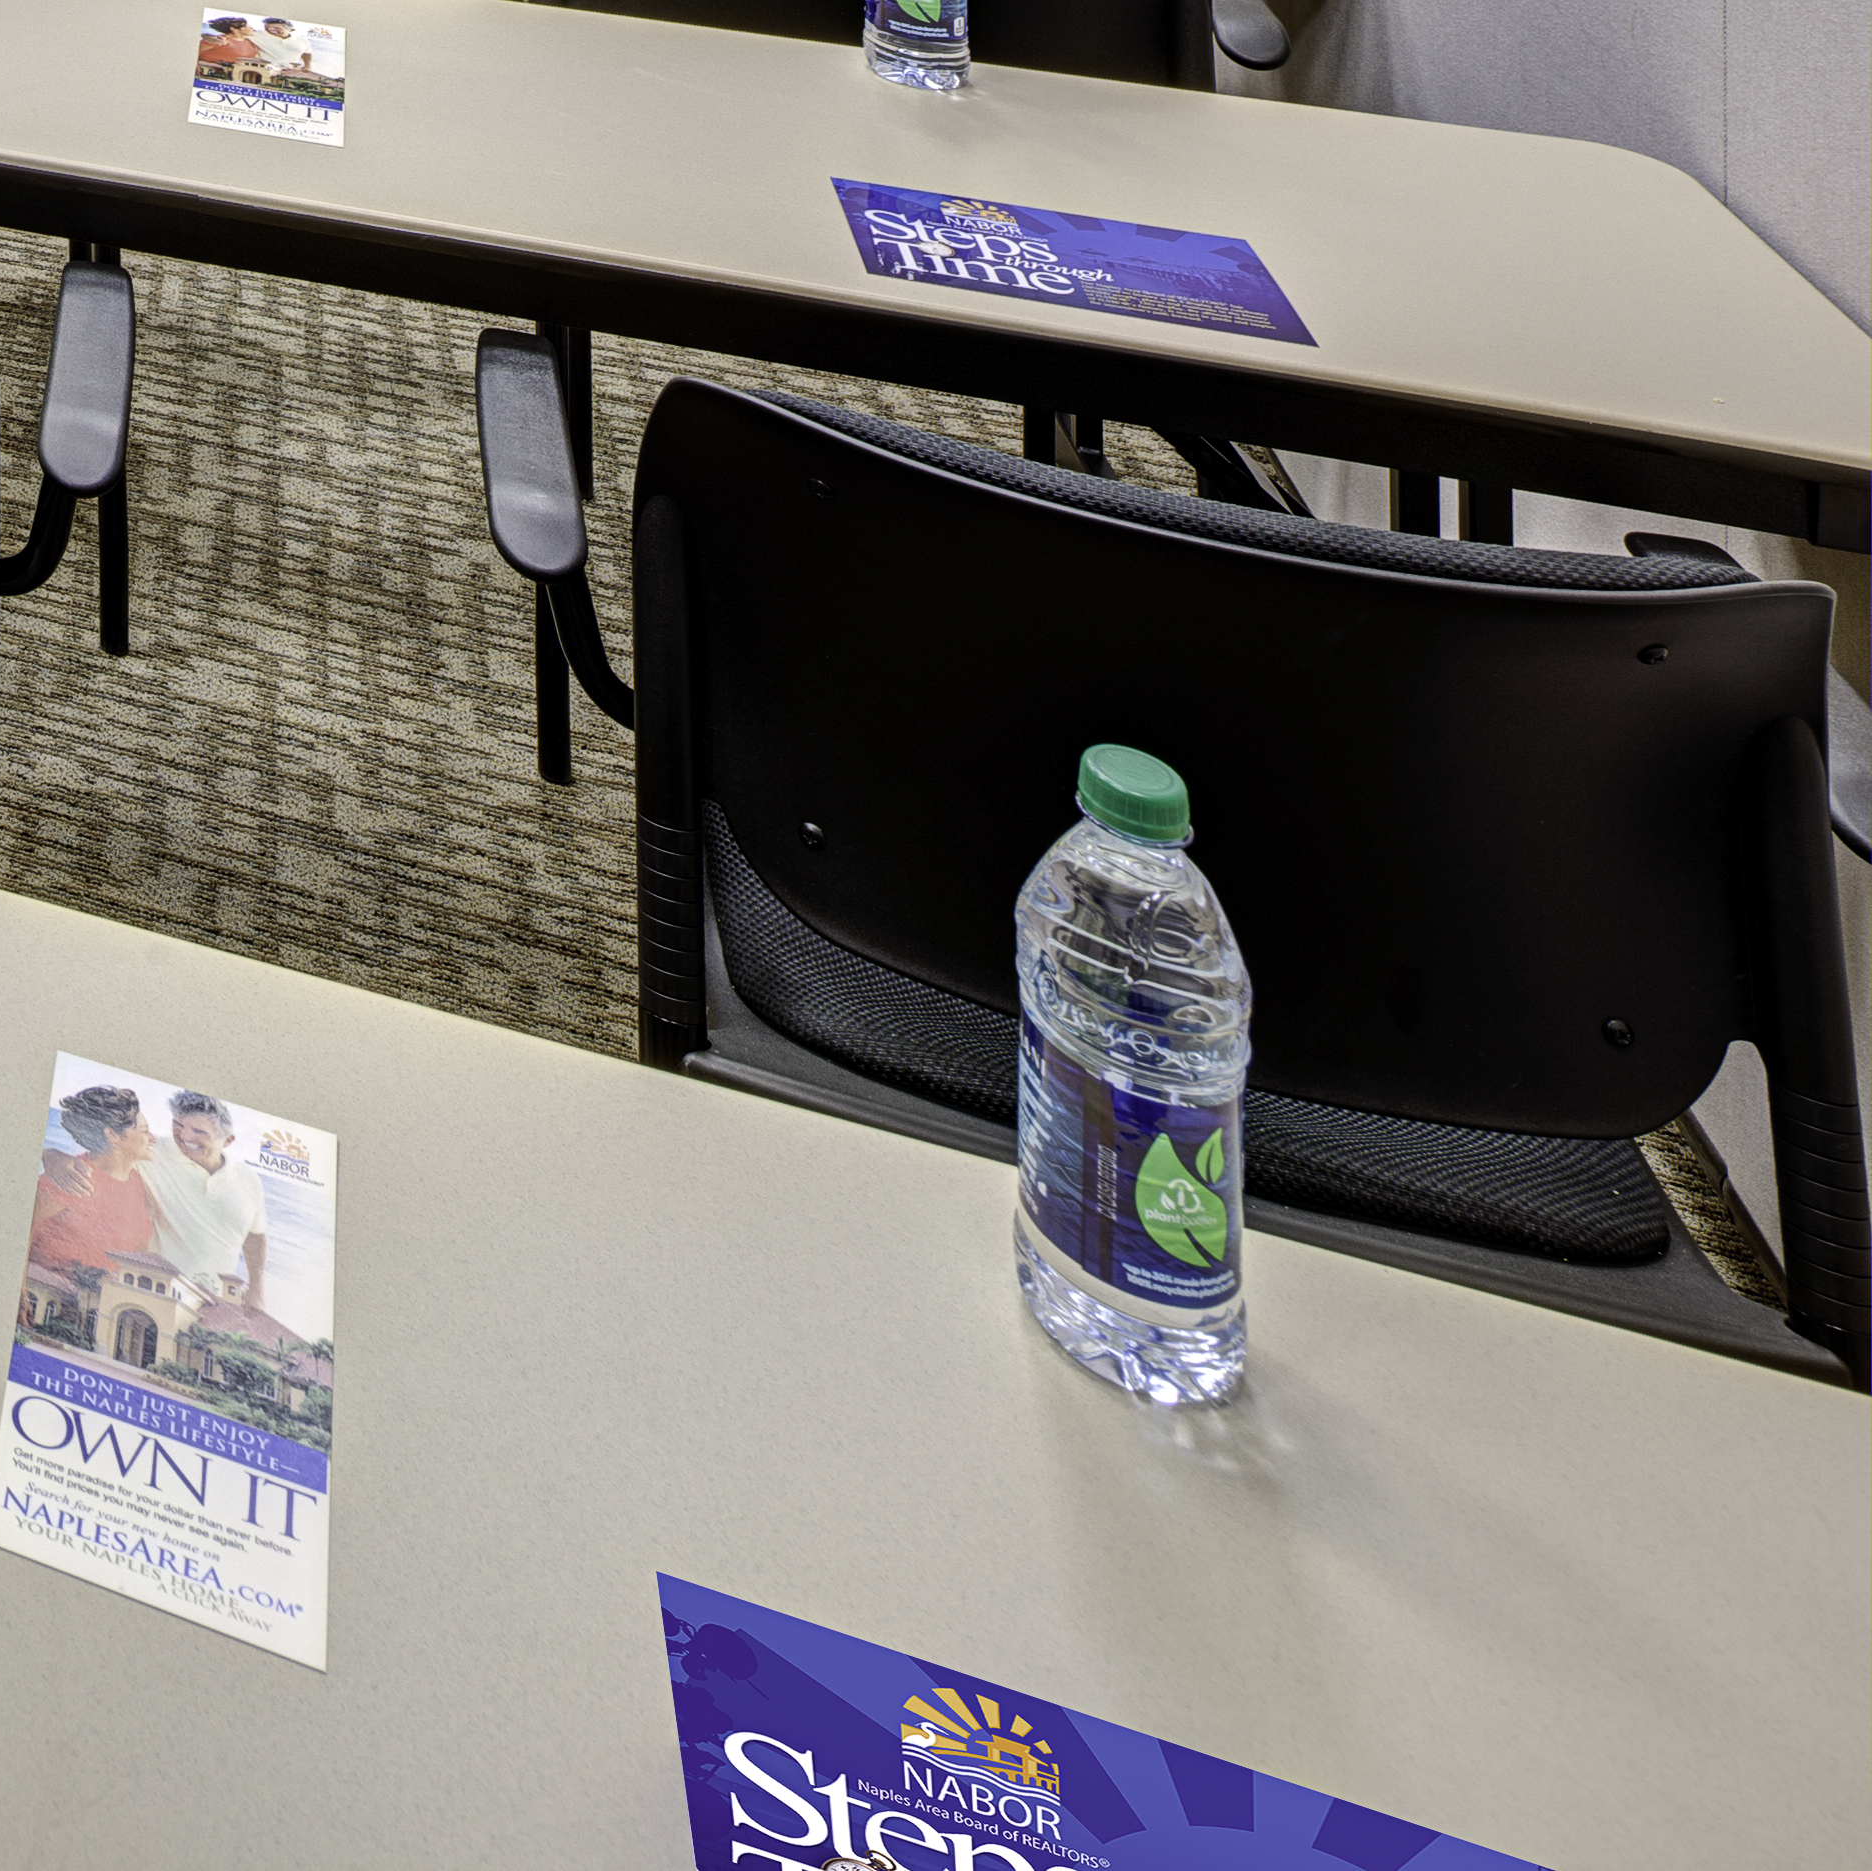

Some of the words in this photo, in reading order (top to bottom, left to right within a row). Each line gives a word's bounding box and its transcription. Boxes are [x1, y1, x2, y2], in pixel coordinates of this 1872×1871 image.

[196, 90, 289, 115] OWN
[864, 209, 1059, 263] Steps
[945, 215, 1024, 237] NABOR
[873, 237, 1076, 296] Time
[1003, 256, 1115, 283] through
[259, 1152, 310, 1178] NABOR
[31, 1371, 74, 1398] THE
[82, 1390, 161, 1429] NAPLES
[63, 1367, 135, 1402] DON'T
[141, 1394, 191, 1422] JUST
[200, 1415, 269, 1450] ENJOY
[11, 1395, 210, 1507] OWN
[241, 1471, 318, 1542] IT
[15, 1515, 75, 1549] YOUR
[82, 1541, 162, 1581] NAPLES
[857, 1778, 912, 1807] Naples
[914, 1798, 950, 1822] Area
[953, 1811, 999, 1837] Board
[1001, 1828, 1023, 1845] of
[902, 1760, 1063, 1841] NABOR
